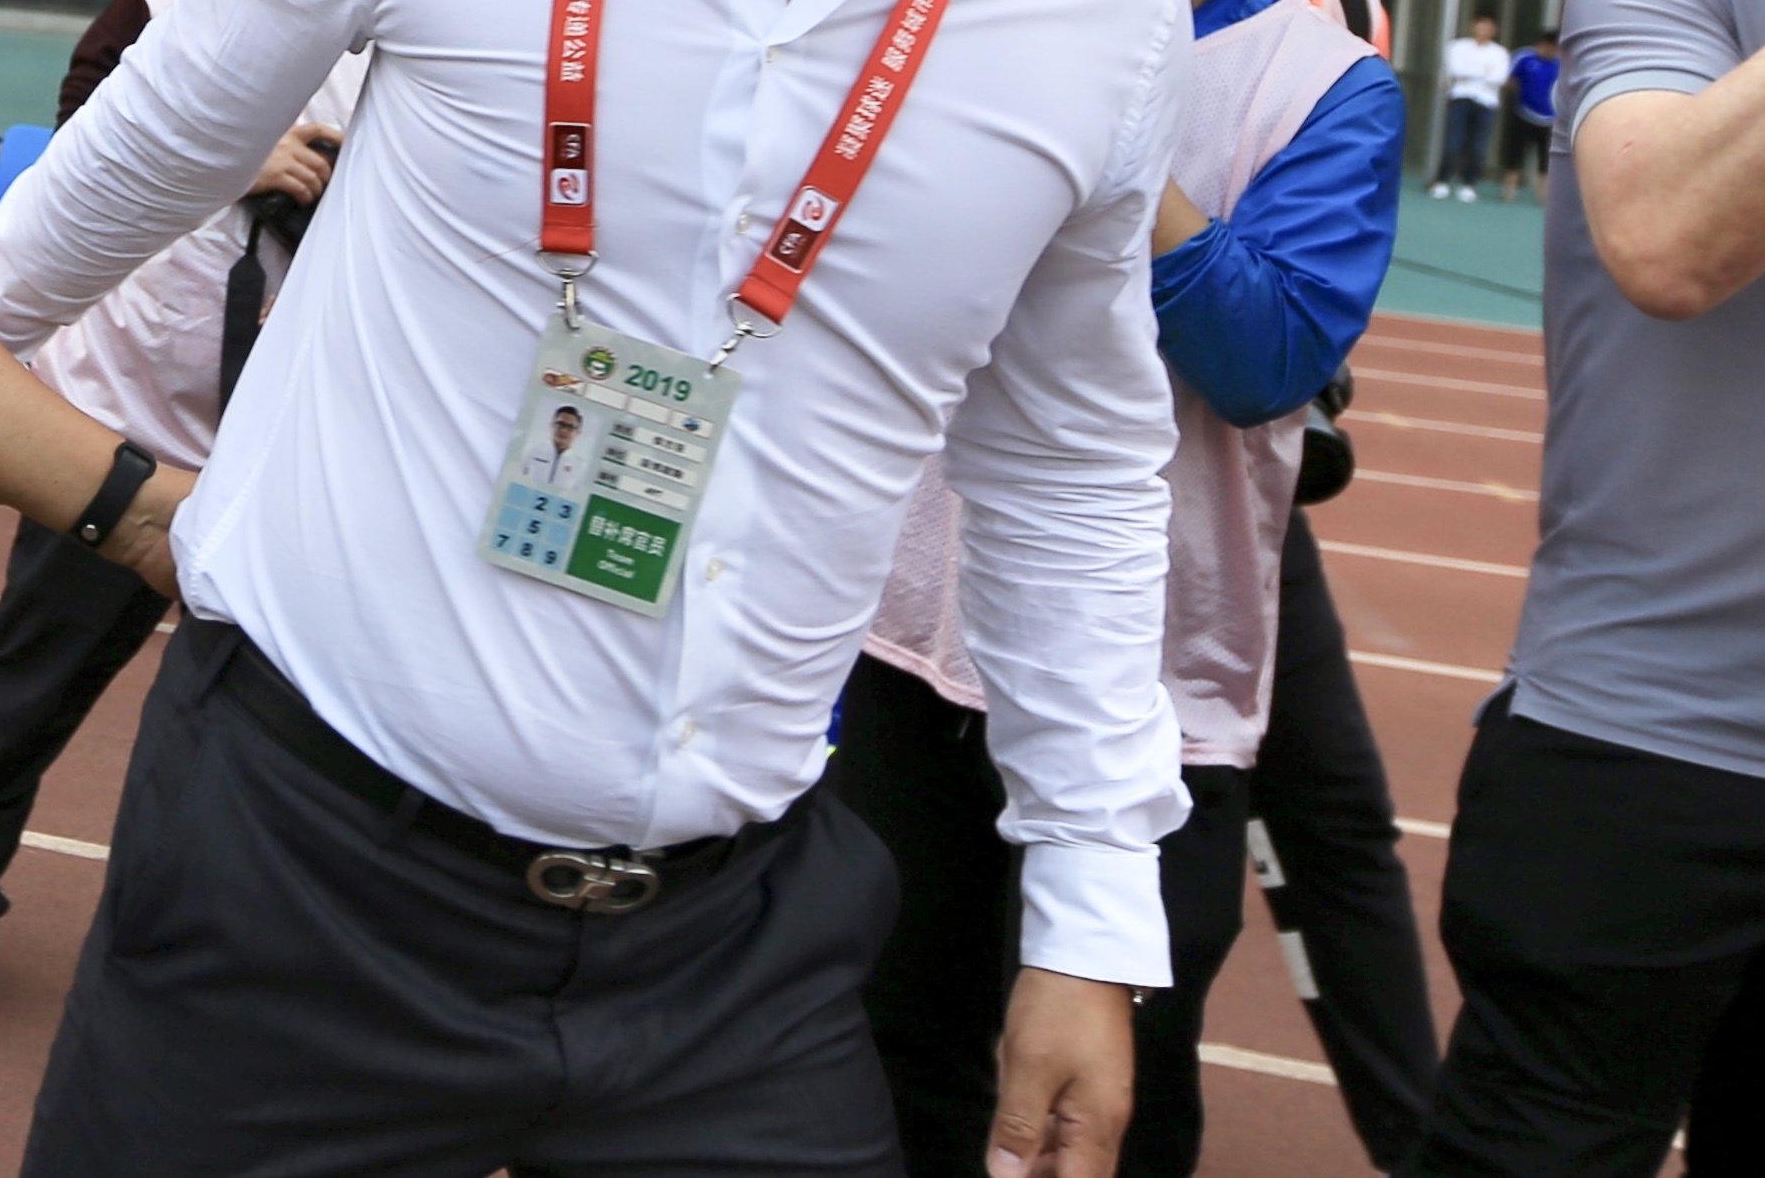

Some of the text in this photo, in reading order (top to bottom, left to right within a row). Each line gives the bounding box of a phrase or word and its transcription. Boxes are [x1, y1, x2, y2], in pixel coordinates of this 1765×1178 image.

[624, 365, 692, 401] 2019
[534, 497, 572, 519] 2 3
[527, 520, 542, 534] 5
[496, 534, 557, 564] 7 8 9
